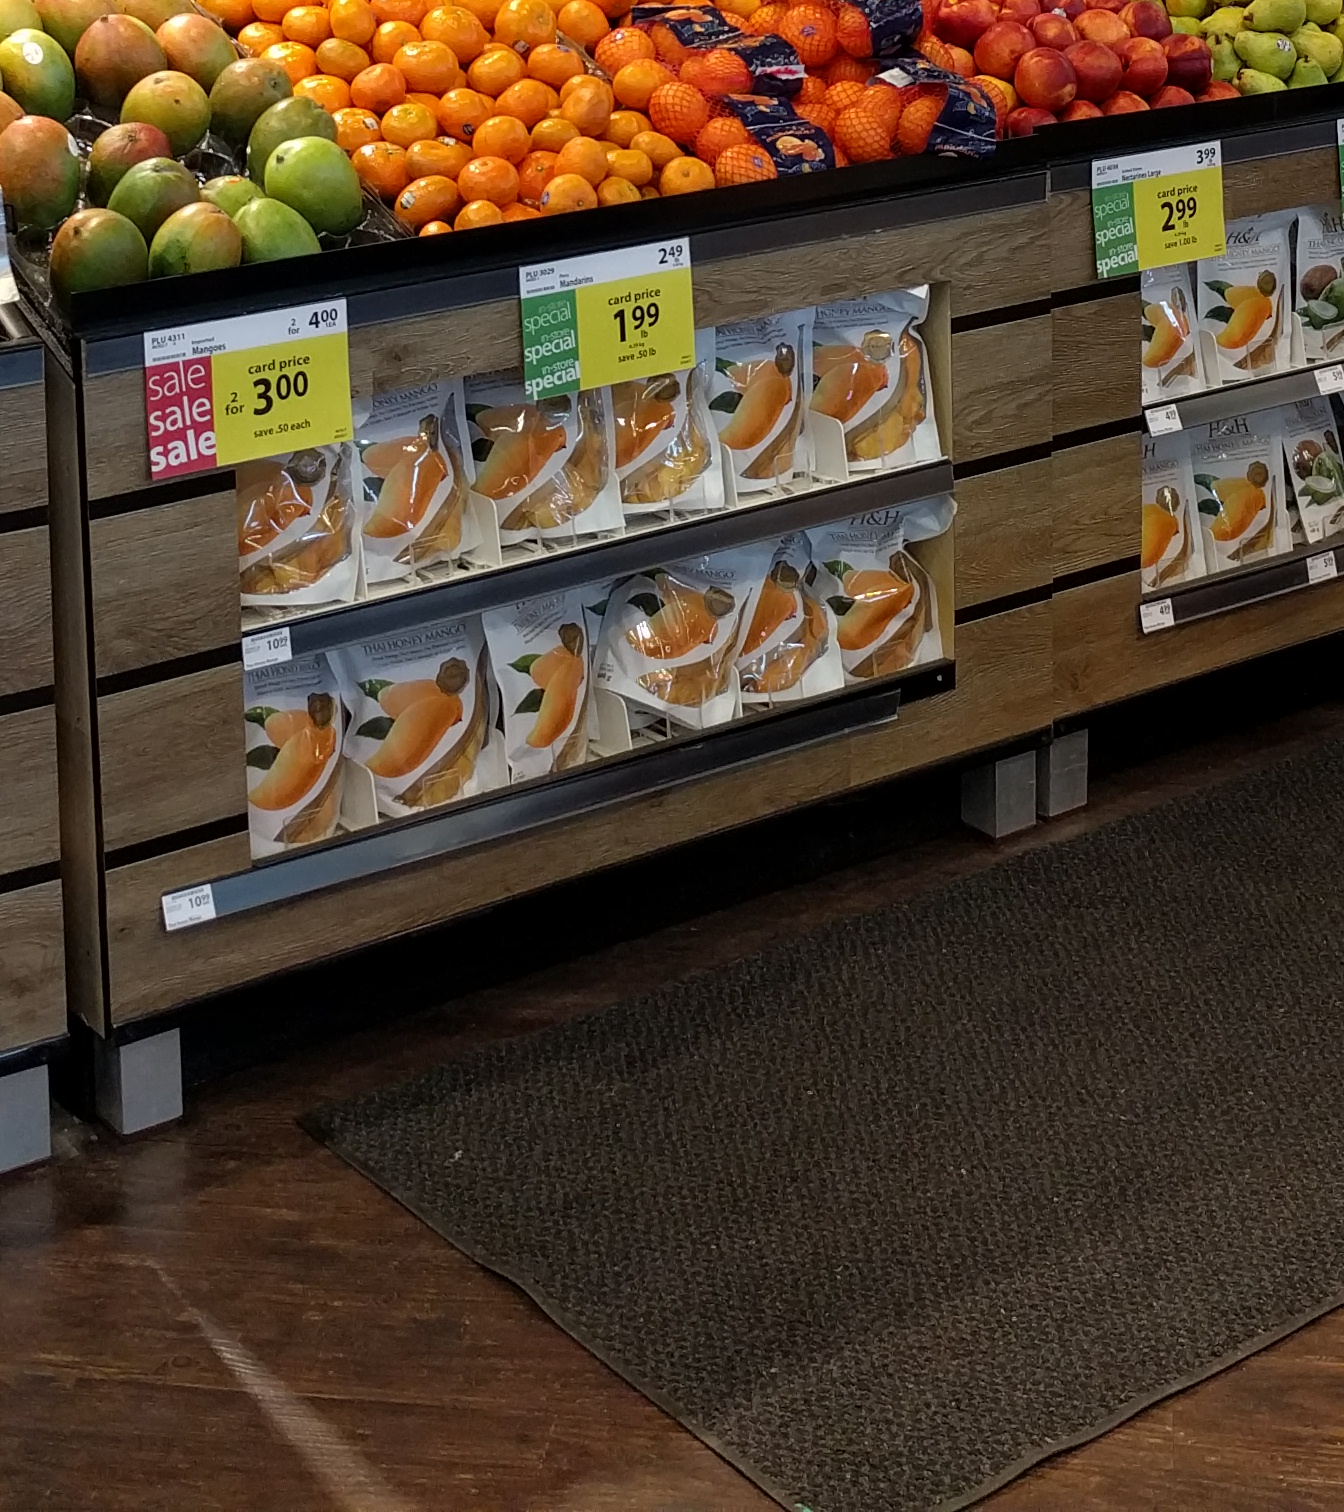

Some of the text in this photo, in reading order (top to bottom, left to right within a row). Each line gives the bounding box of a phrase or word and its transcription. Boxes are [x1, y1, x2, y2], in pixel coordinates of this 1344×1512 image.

[1157, 185, 1198, 199] card price
[1096, 216, 1134, 248] special
[1096, 245, 1138, 279] special
[608, 287, 661, 306] card price
[524, 302, 572, 335] special
[288, 326, 300, 335] for
[192, 342, 226, 356] Mangoes
[524, 329, 576, 365] special
[248, 355, 311, 375] card price
[618, 353, 635, 363] save
[148, 360, 206, 401] sale
[525, 360, 581, 401] special
[230, 392, 238, 403] 2
[149, 396, 211, 437] sale
[225, 403, 245, 416] for
[254, 419, 311, 438] save each
[150, 429, 217, 472] sale
